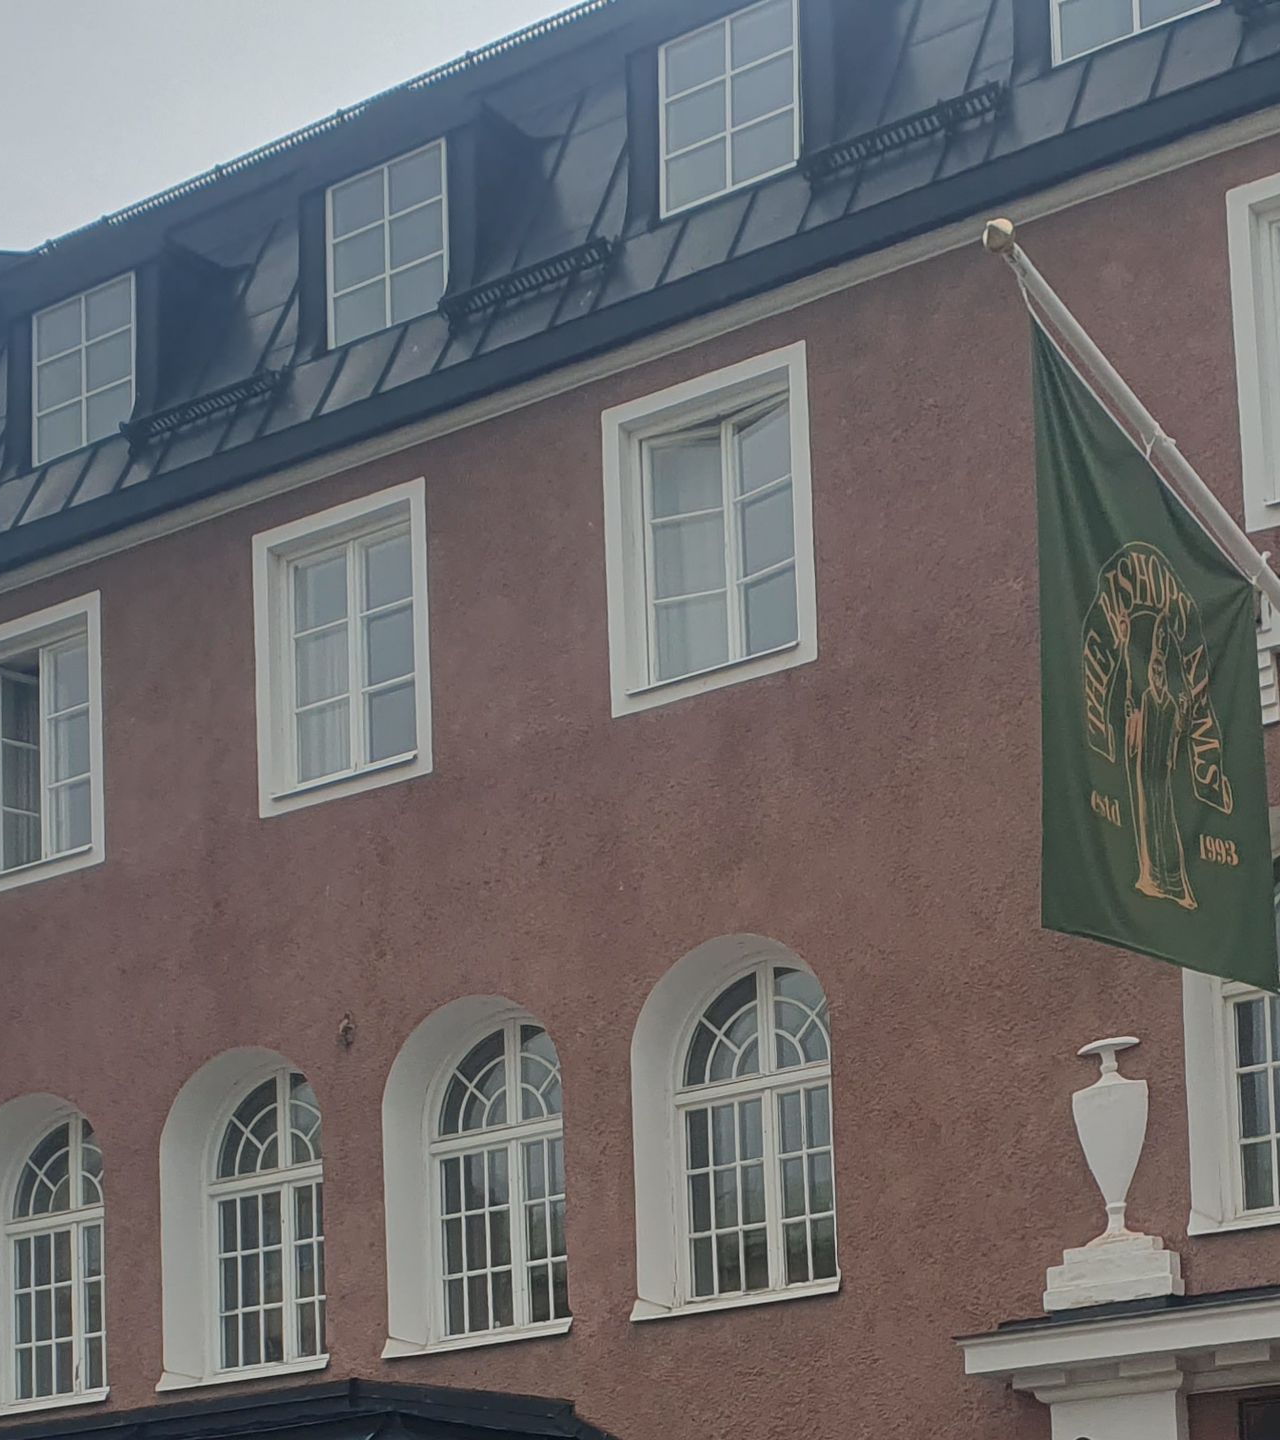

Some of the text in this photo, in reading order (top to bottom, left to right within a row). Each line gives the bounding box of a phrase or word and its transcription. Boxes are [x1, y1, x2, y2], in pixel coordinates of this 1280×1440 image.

[1083, 550, 1221, 793] THE BISHOPS ARMS
[1090, 789, 1240, 867] estd 1993
